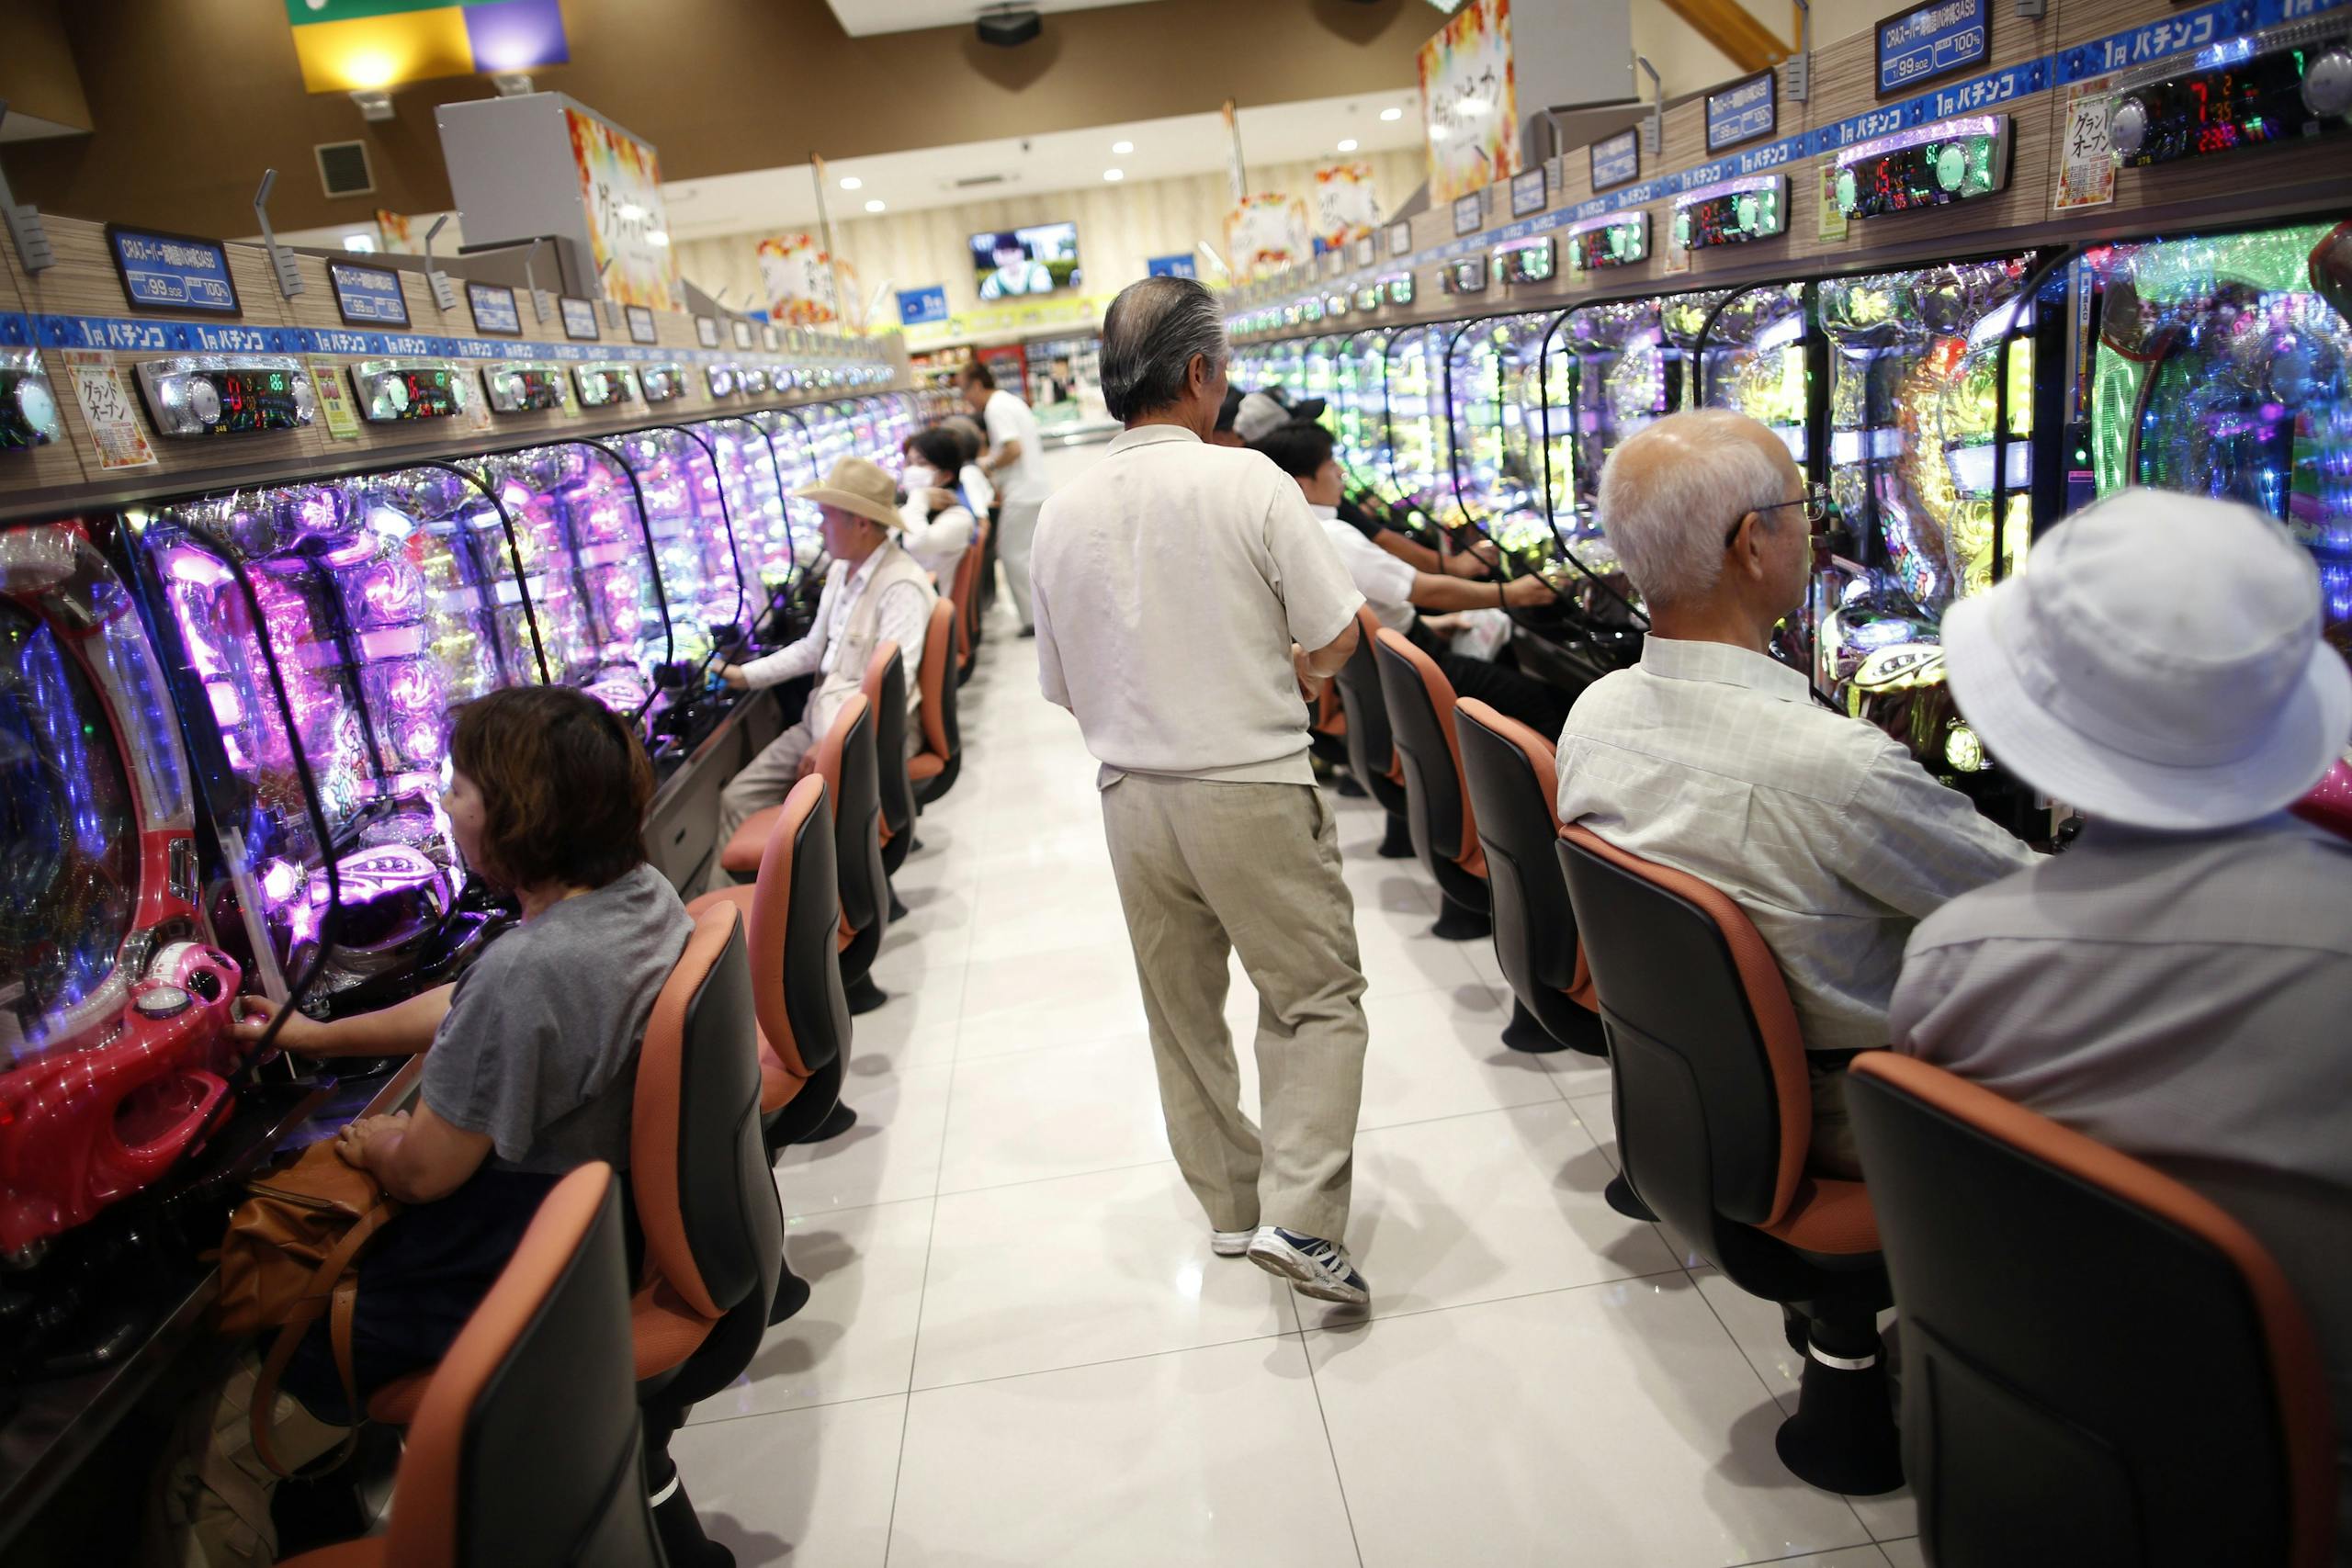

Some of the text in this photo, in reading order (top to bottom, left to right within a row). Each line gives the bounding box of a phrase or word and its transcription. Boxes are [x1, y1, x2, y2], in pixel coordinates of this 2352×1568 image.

[1954, 32, 1980, 52] 100%
[2104, 14, 2213, 69] 1円パチンコ
[1936, 73, 2014, 117] 1円パチンコ
[79, 321, 165, 348] 1円パチンコ
[197, 327, 265, 350] 1円パチンコ
